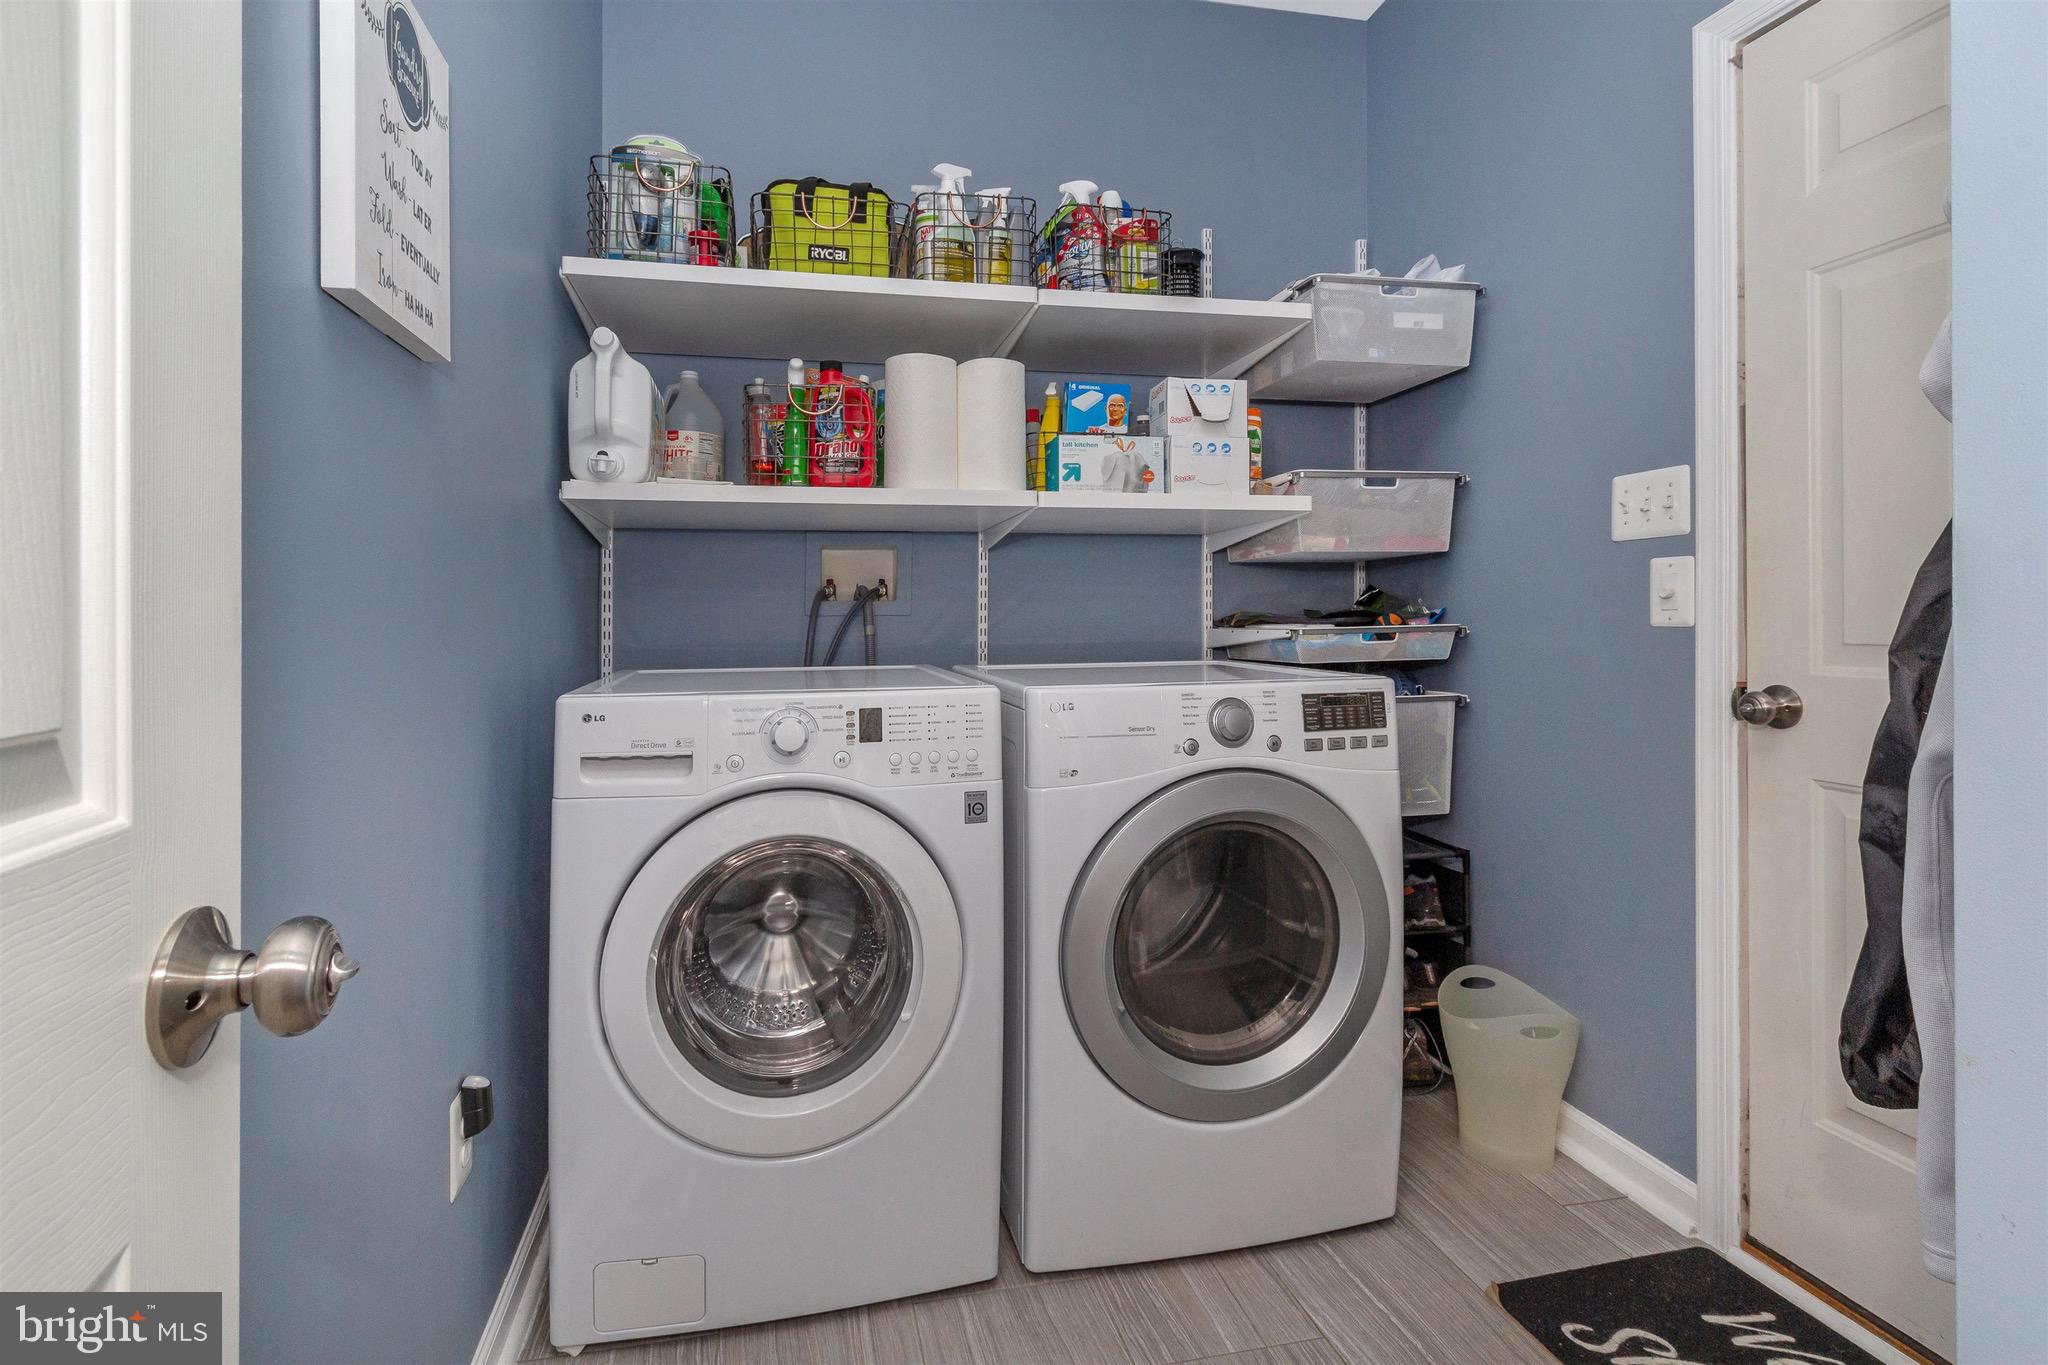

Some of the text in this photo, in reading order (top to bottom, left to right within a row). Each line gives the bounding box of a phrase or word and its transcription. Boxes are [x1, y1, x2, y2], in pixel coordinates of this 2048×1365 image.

[380, 98, 406, 148] Sort
[380, 151, 407, 204] Wash
[412, 199, 432, 234] LATER
[369, 186, 393, 239] Fold
[400, 233, 440, 285] EVENTUALLY
[376, 249, 398, 297] Iron
[594, 714, 606, 722] LG
